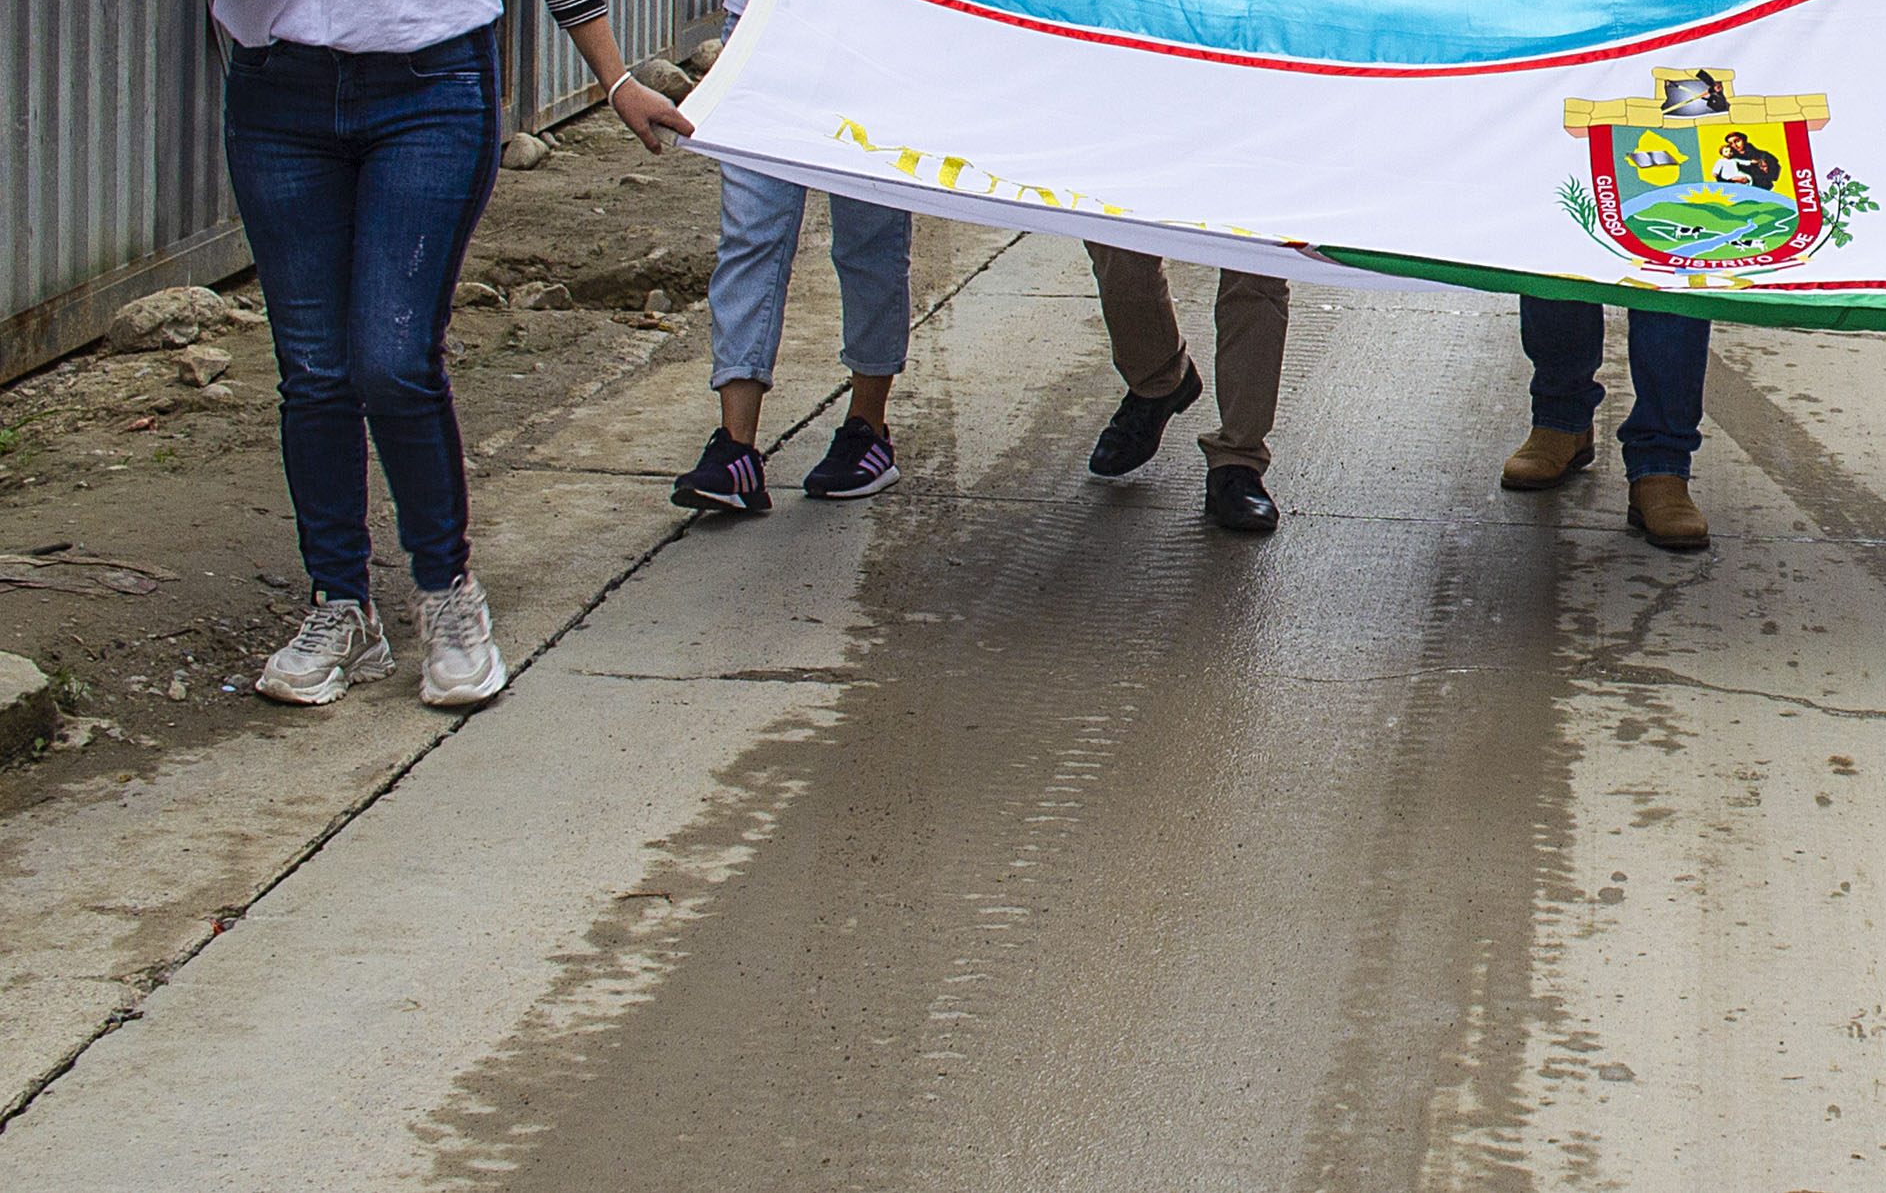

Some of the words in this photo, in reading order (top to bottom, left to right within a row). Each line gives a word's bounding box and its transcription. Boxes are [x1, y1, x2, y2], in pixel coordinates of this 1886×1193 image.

[1596, 175, 1627, 237] GLORIOSO
[1796, 168, 1818, 213] LAJAS
[1789, 232, 1813, 249] DE
[1668, 255, 1773, 268] DISTRITO
